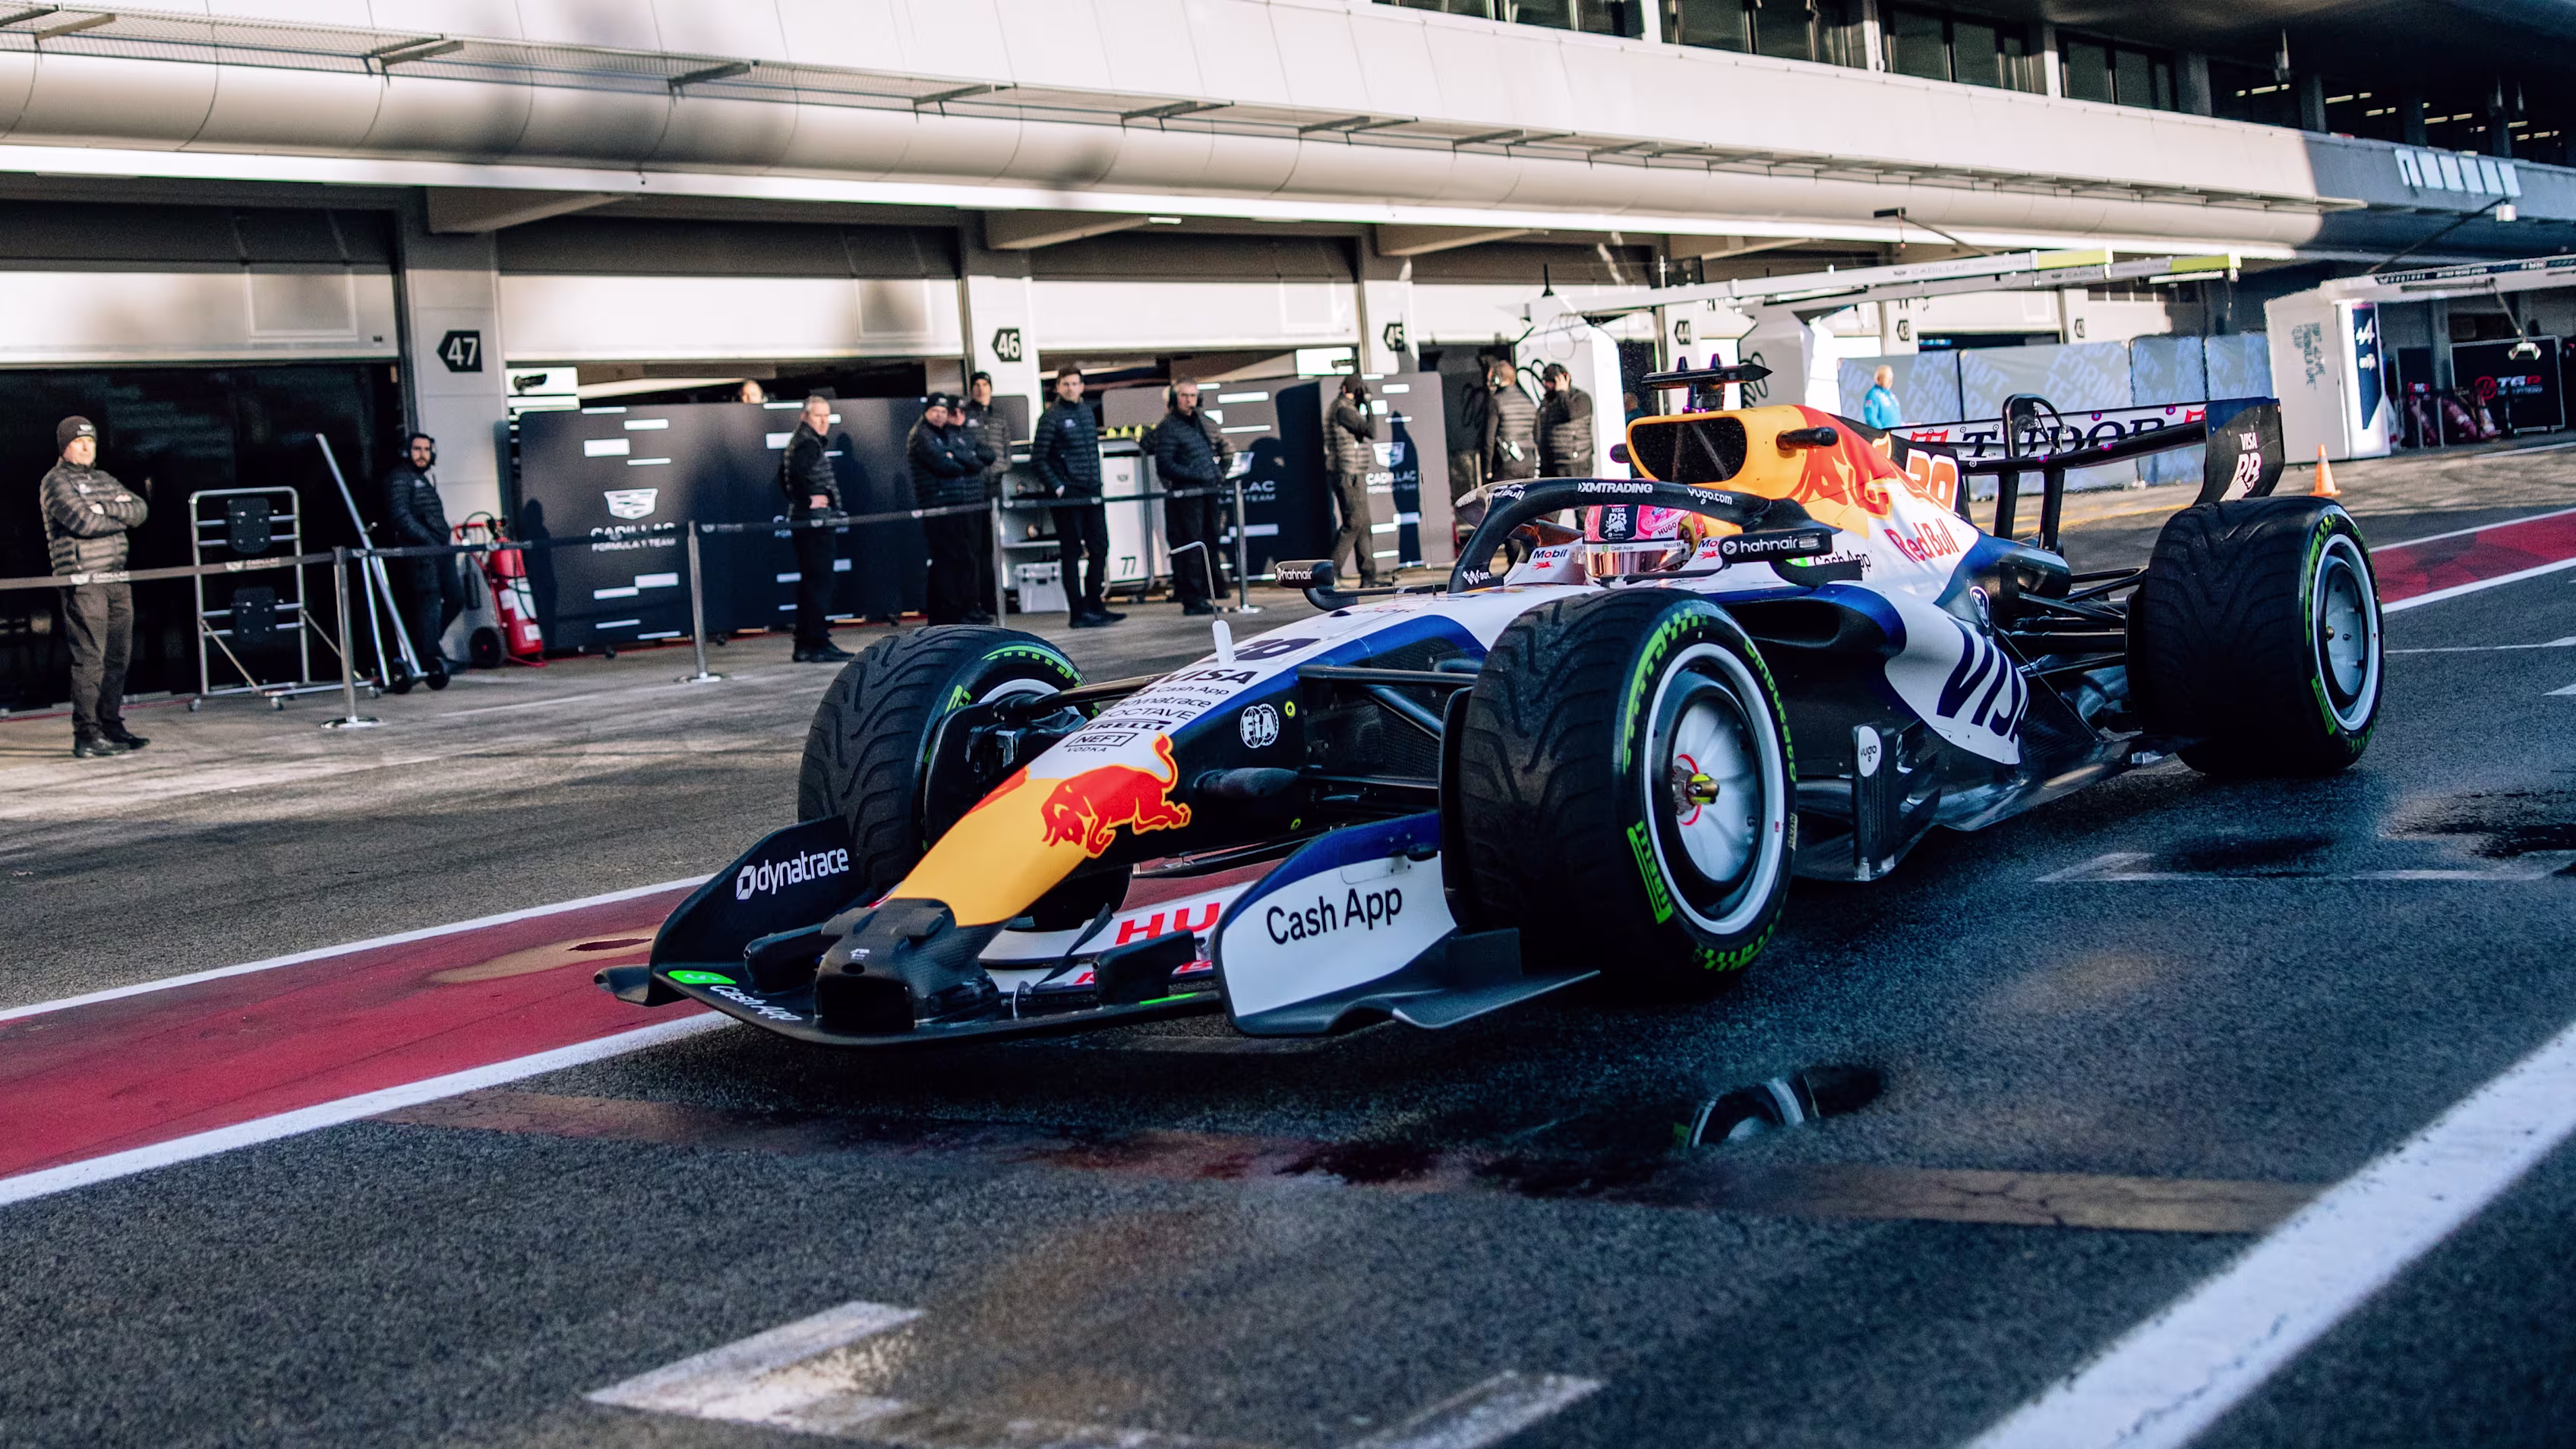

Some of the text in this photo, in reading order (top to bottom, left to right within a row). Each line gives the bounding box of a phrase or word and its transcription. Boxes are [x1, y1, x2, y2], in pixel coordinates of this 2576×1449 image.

[1677, 322, 1690, 343] 44
[447, 337, 478, 366] 47
[996, 332, 1020, 358] 46
[2239, 431, 2259, 451] VISA
[1581, 482, 1653, 494] XMTRADING
[1687, 488, 1733, 505] yugo.com
[1658, 522, 1678, 536] HUGO
[1740, 535, 1799, 553] hahnair
[1883, 517, 1960, 564] Red Bull
[1533, 548, 1568, 559] Mobil
[1121, 556, 1136, 576] 77
[1281, 568, 1313, 581] hahnair
[1160, 669, 1259, 685] VISA
[1156, 685, 1230, 696] Cash App
[1126, 696, 1214, 708] dynatrace
[1110, 708, 1197, 721] OCTAVE
[1077, 734, 1128, 744] NEFT
[1860, 745, 1878, 762] yugo
[756, 848, 850, 895] dynatrace
[1266, 886, 1403, 945] Cash App
[709, 985, 803, 1021] Cash App
